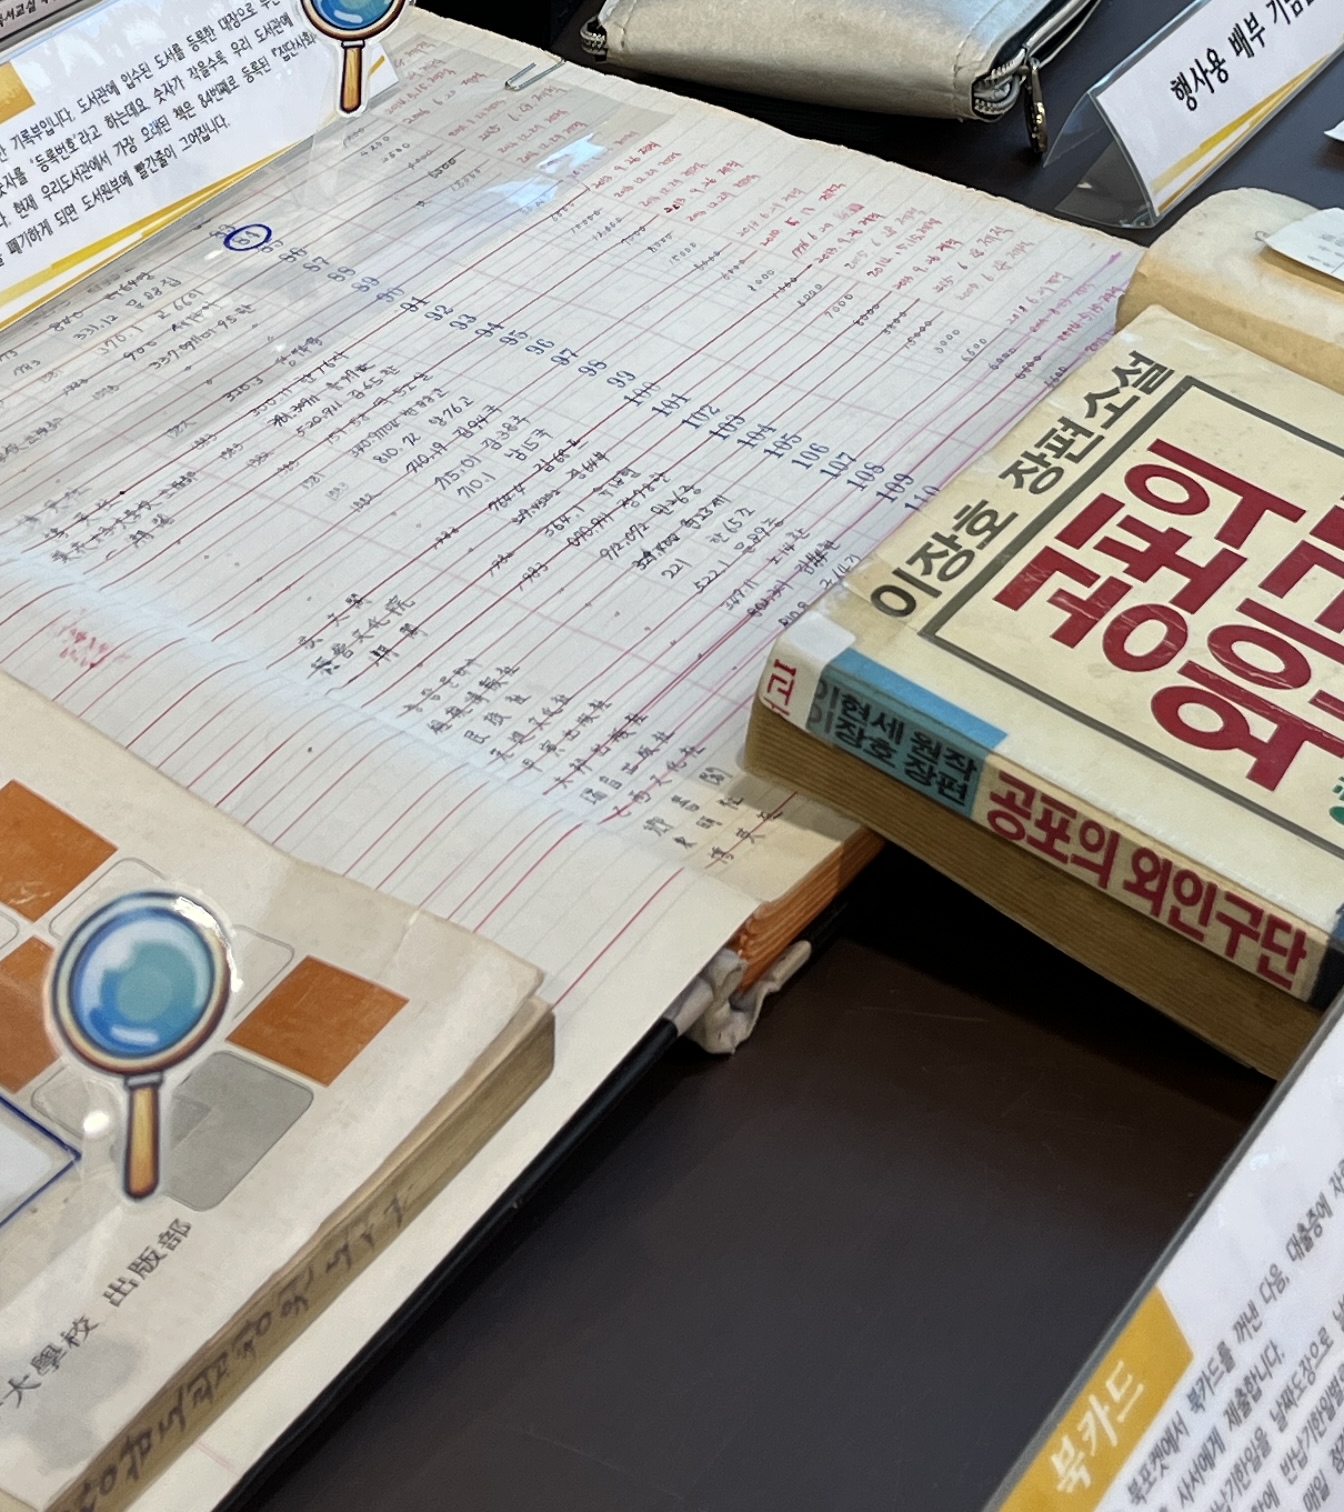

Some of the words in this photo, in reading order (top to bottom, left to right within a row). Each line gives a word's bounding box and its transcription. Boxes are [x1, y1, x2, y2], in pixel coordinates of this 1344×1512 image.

[9, 110, 76, 152] 기록부입니다.
[76, 79, 122, 114] 도서관에
[121, 61, 154, 92] 입수된
[154, 42, 187, 71] 도서를
[186, 24, 217, 53] 등록한
[217, 3, 258, 33] 대장으로
[152, 74, 185, 105] 숫자가
[186, 49, 230, 80] 작을수록
[230, 35, 253, 59] 우리
[253, 11, 295, 45] 도서관에
[1169, 45, 1232, 113] 행사용
[1227, 11, 1268, 61] 배부
[6, 218, 54, 255] 폐기하게
[53, 202, 79, 228] 되면
[80, 168, 134, 212] 도서원부에
[134, 143, 179, 181] 빨간줄이
[180, 113, 232, 153] 그어집니다.
[12, 193, 39, 221] 현재
[40, 149, 113, 204] 우리도서관에서
[112, 136, 138, 163] 가장
[140, 114, 172, 145] 오래된
[173, 98, 197, 122] 책은
[200, 74, 242, 110] 84번째로
[241, 56, 273, 85] 등록된
[400, 295, 430, 313] 91
[424, 304, 455, 322] 92
[474, 321, 505, 339] 94
[525, 338, 556, 356] 96
[577, 358, 609, 377] 98
[623, 379, 662, 409] 100
[681, 403, 722, 430] 102
[763, 431, 803, 461] 105
[820, 450, 858, 482] 107
[869, 497, 1021, 620] 이장호
[998, 349, 1177, 499] 장편소설
[875, 471, 916, 505] 109
[992, 438, 1307, 675] 공포의
[807, 698, 899, 769] 이장호
[905, 751, 968, 806] 장편
[815, 677, 905, 749] 이현세
[911, 724, 979, 777] 원작
[986, 766, 1120, 889] 공포의
[1122, 844, 1308, 990] 외인구단
[1126, 1409, 1191, 1508] 북포켓에서
[1186, 1339, 1237, 1416] 북카드를
[1232, 1301, 1264, 1345] 꺼낸
[1258, 1262, 1292, 1307] 다음,
[1285, 1191, 1335, 1263] 대출증에
[1269, 1325, 1336, 1434] 날짜도장으로
[1050, 1359, 1145, 1494] 북카드
[1176, 1425, 1227, 1509] 사서에게
[1222, 1339, 1287, 1433] 제출합니다.
[1302, 1468, 1332, 1512] 매일
